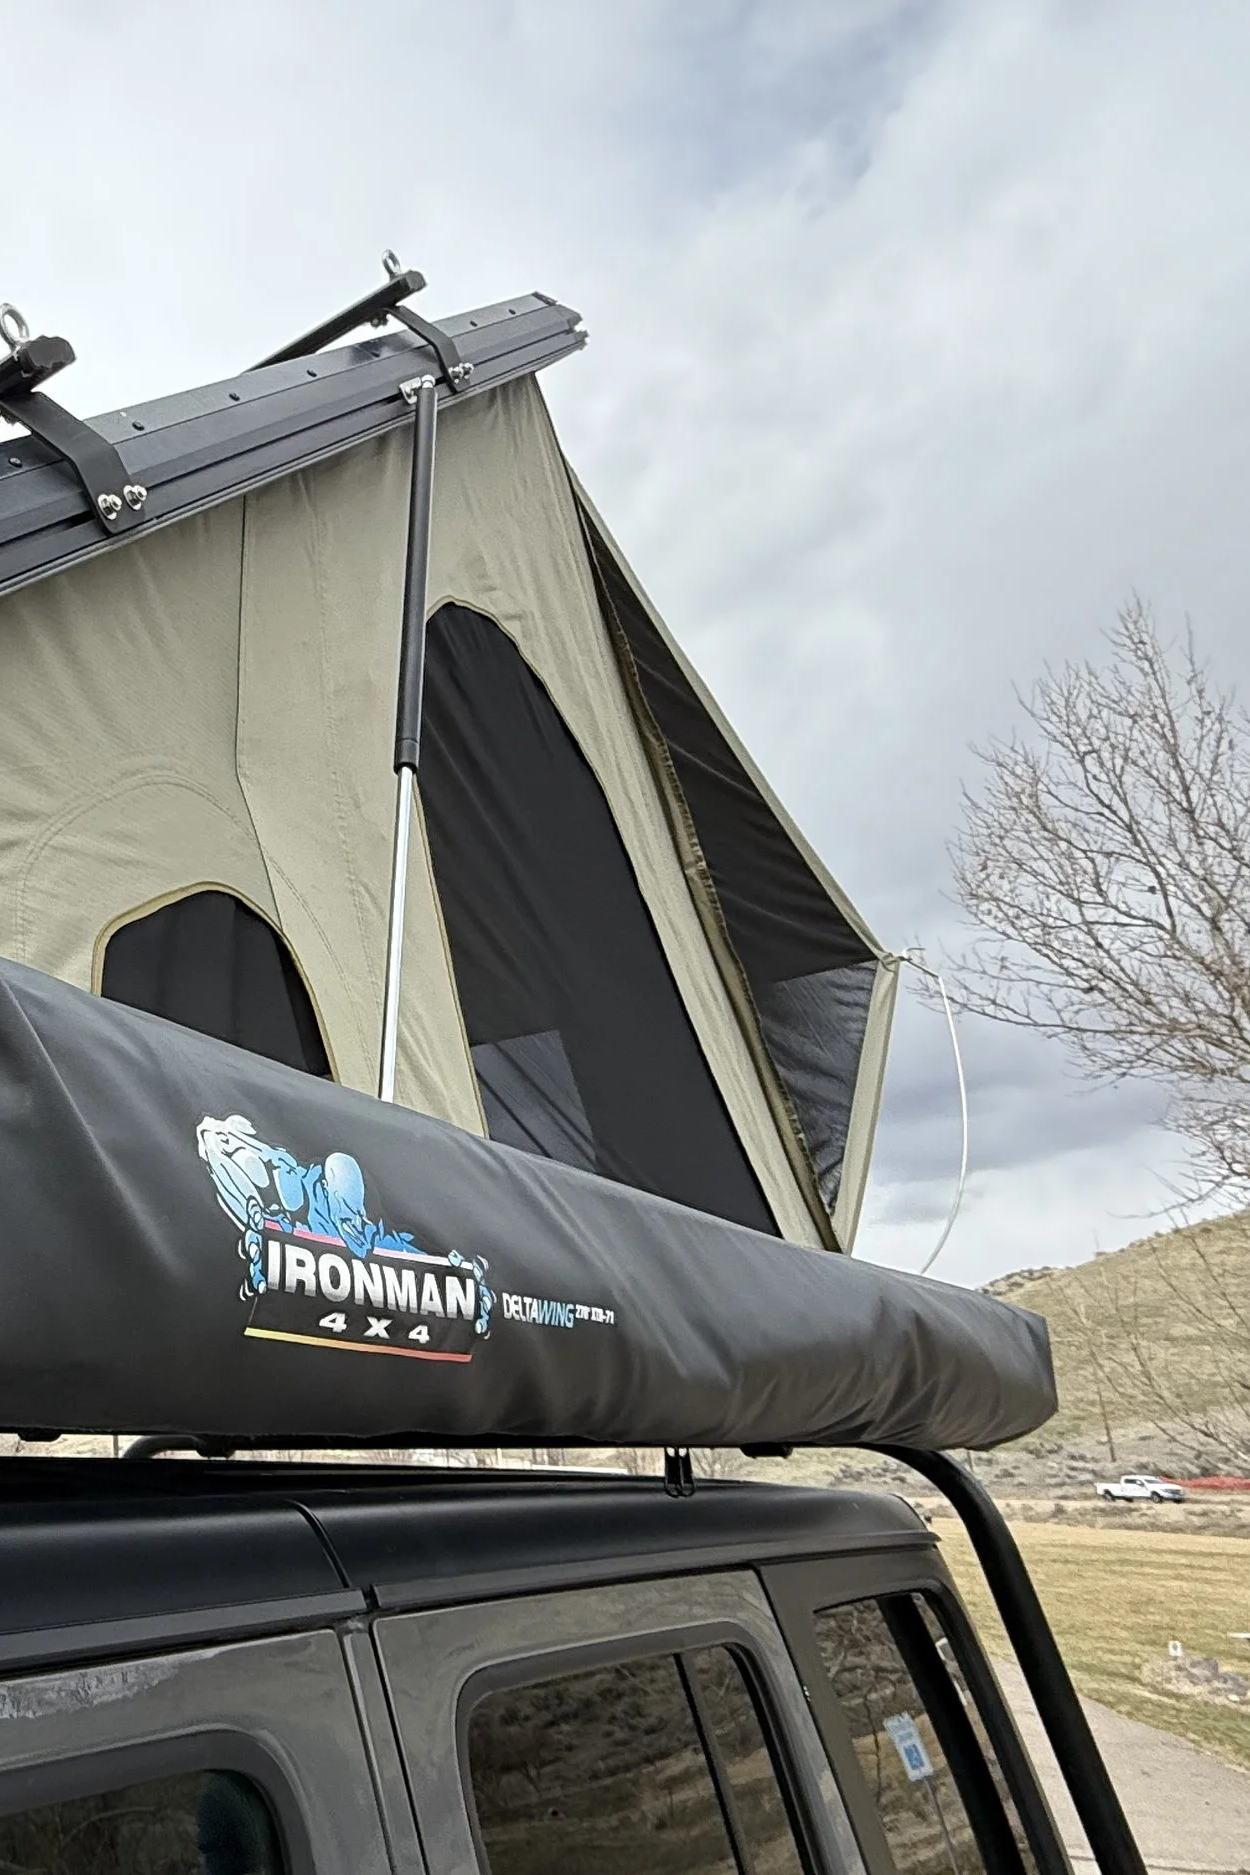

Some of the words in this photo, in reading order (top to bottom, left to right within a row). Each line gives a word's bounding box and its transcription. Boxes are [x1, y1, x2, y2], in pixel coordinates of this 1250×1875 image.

[267, 1240, 475, 1321] IRONMAN
[318, 1311, 348, 1333] 4
[363, 1315, 393, 1339] X
[407, 1324, 431, 1344] 4
[501, 1292, 574, 1329] DELTAWING
